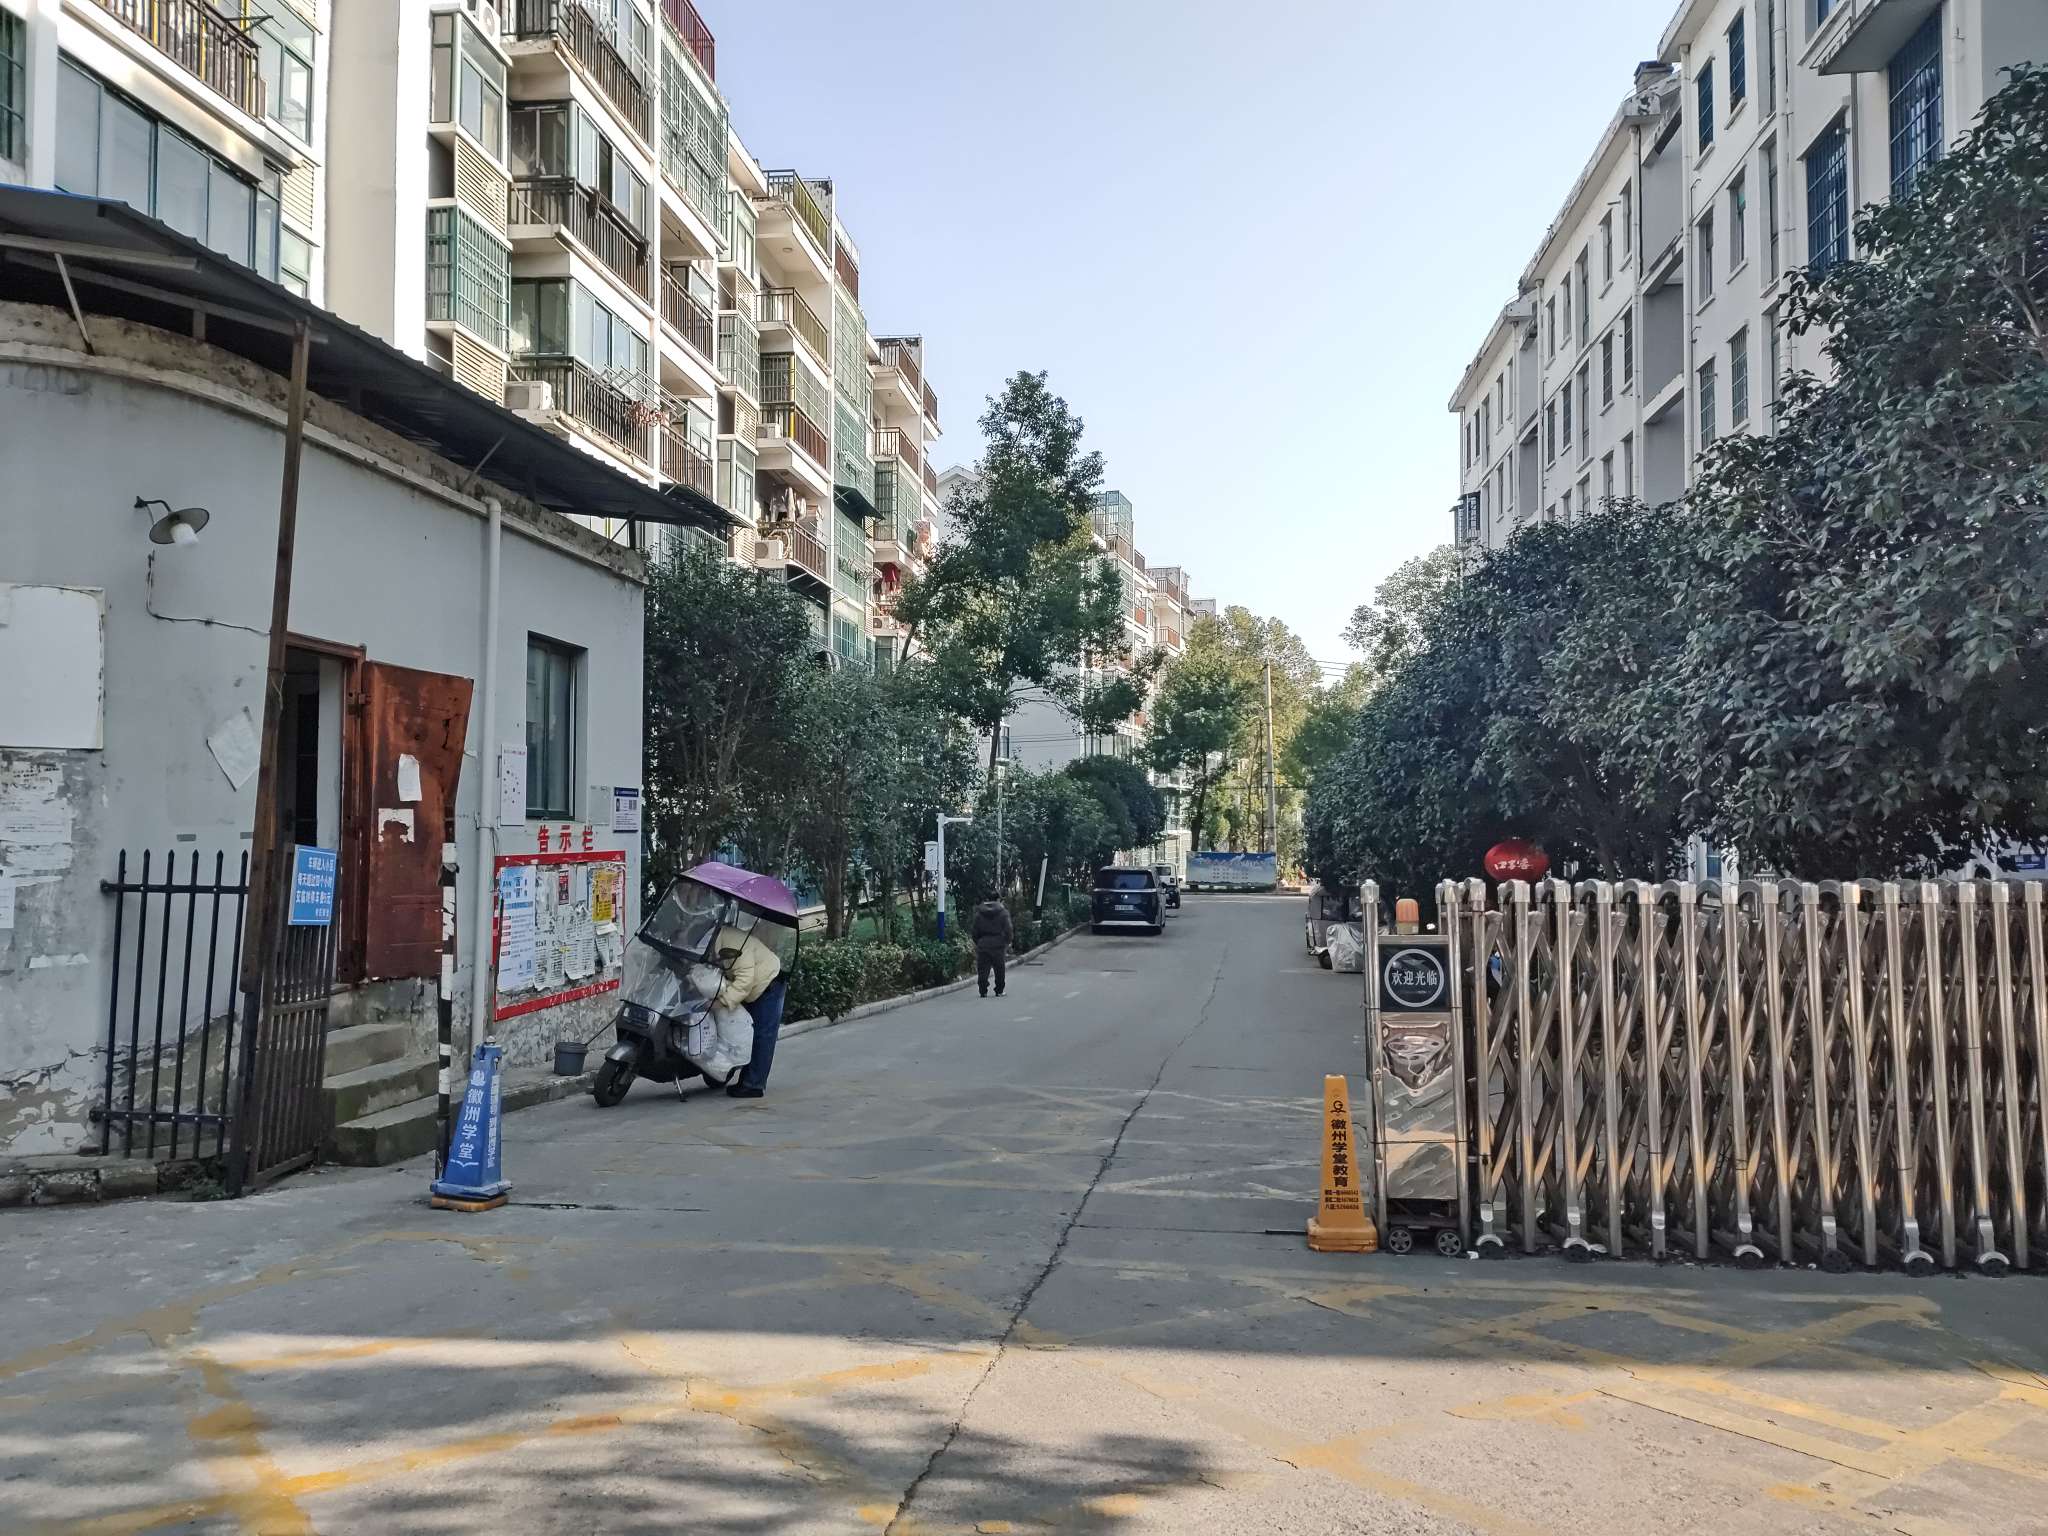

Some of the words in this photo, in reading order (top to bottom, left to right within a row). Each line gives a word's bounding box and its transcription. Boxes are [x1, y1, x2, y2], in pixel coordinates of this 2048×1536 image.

[1391, 970, 1438, 986] 欢迎光临
[458, 1088, 484, 1160] 徽洲学堂
[1331, 1119, 1349, 1187] 徽州学堂教育
